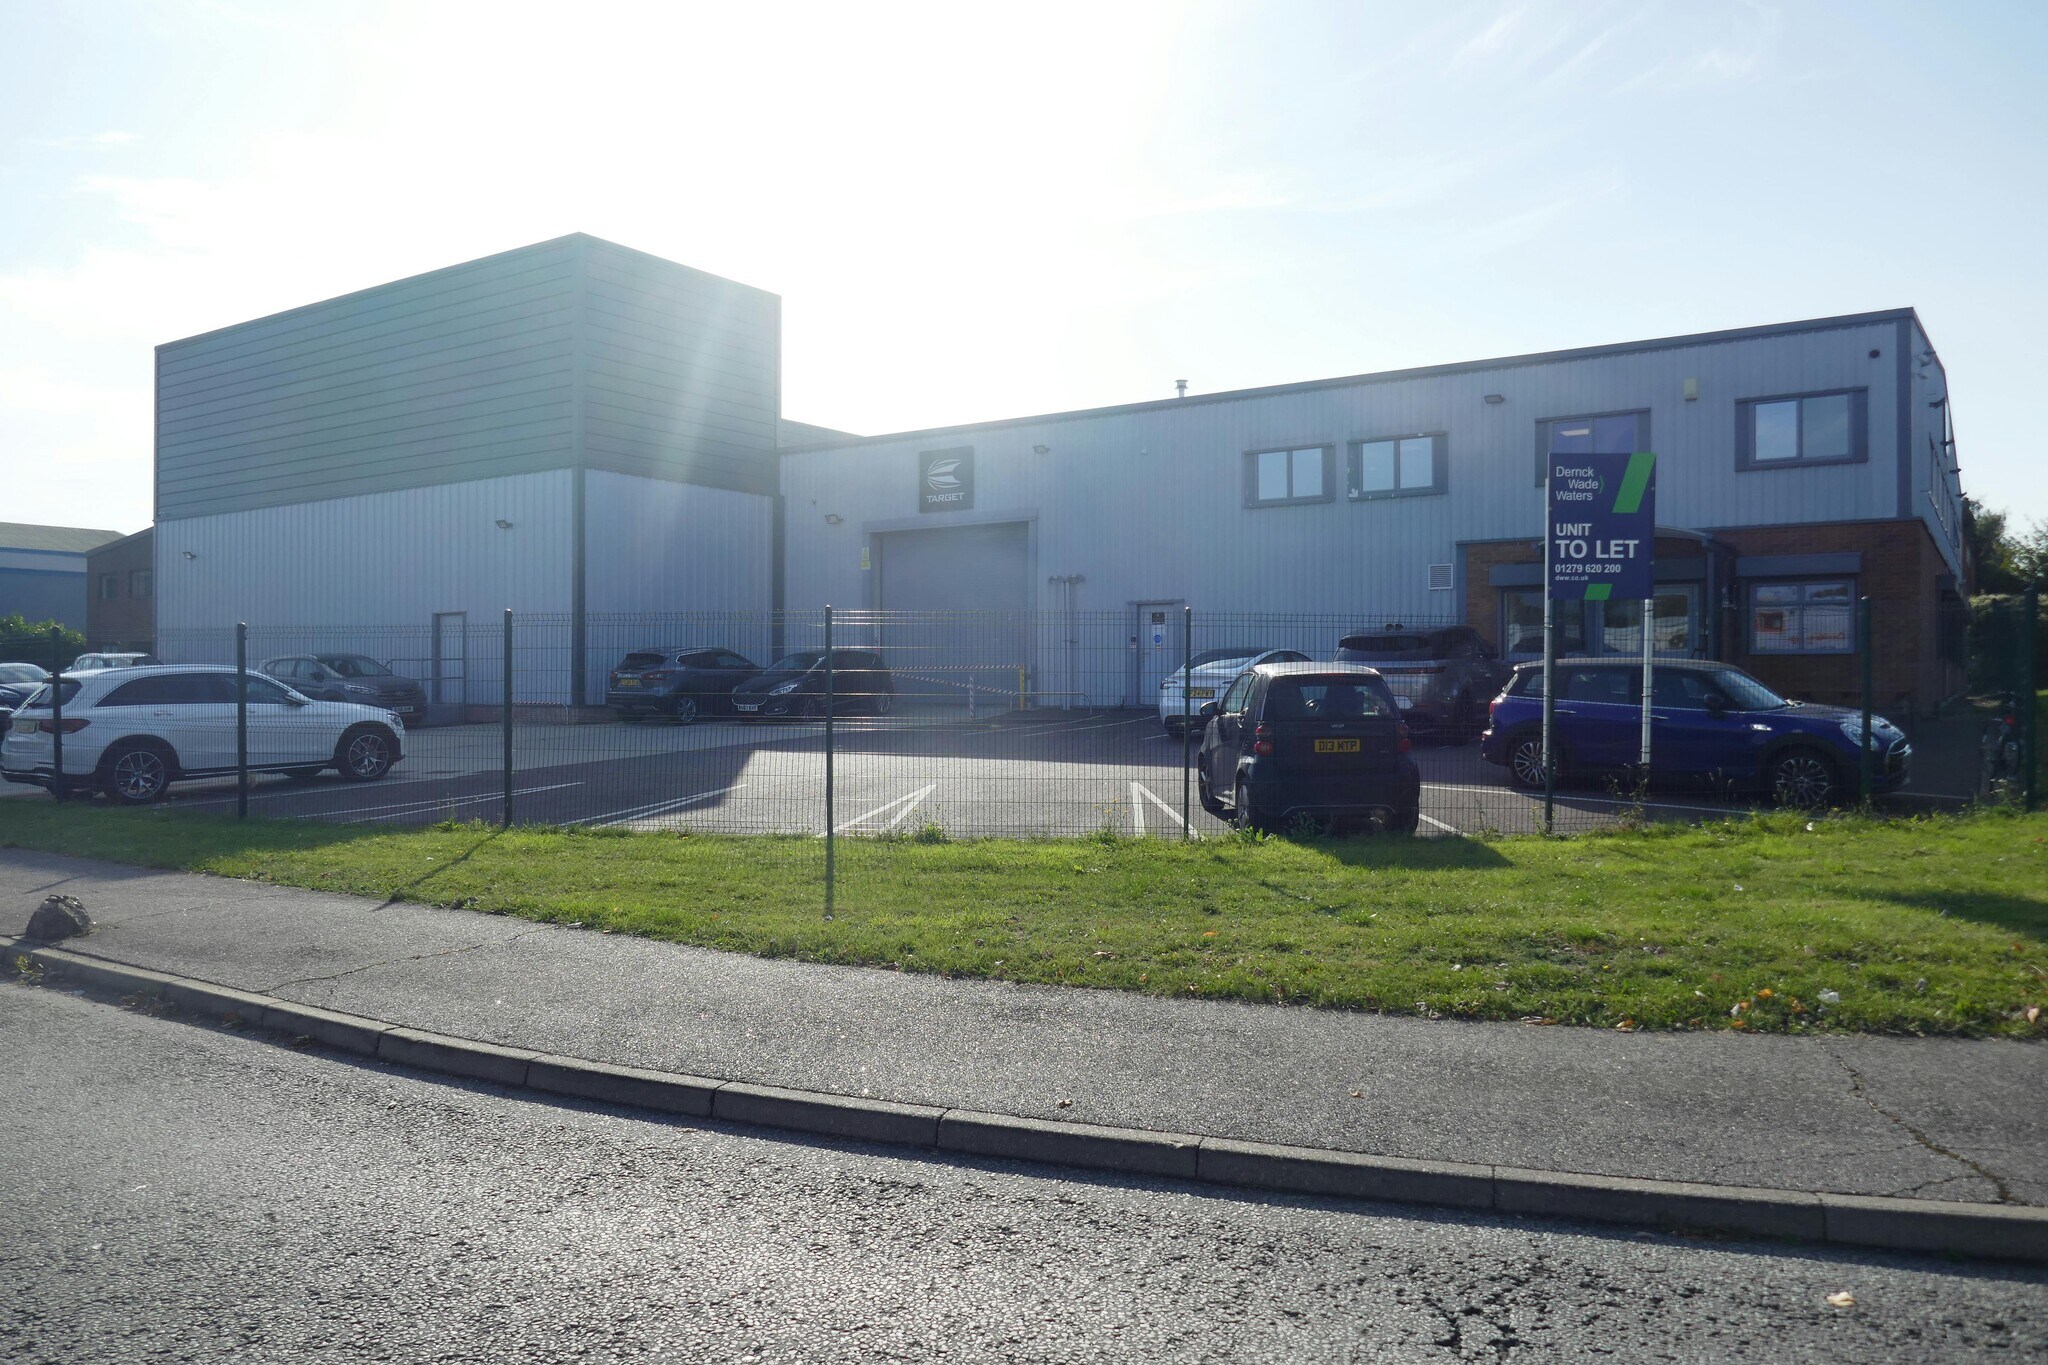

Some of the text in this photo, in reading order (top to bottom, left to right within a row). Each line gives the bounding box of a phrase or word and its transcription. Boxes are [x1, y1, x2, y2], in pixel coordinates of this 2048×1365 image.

[1556, 466, 1594, 477] Derrick
[1568, 478, 1599, 489] Wade
[926, 492, 965, 503] TARGET
[1555, 491, 1593, 501] Waters
[1555, 523, 1592, 536] UNIT
[1555, 539, 1640, 559] TO LET
[1555, 564, 1621, 573] 01279 620 200
[1318, 740, 1335, 751] D13
